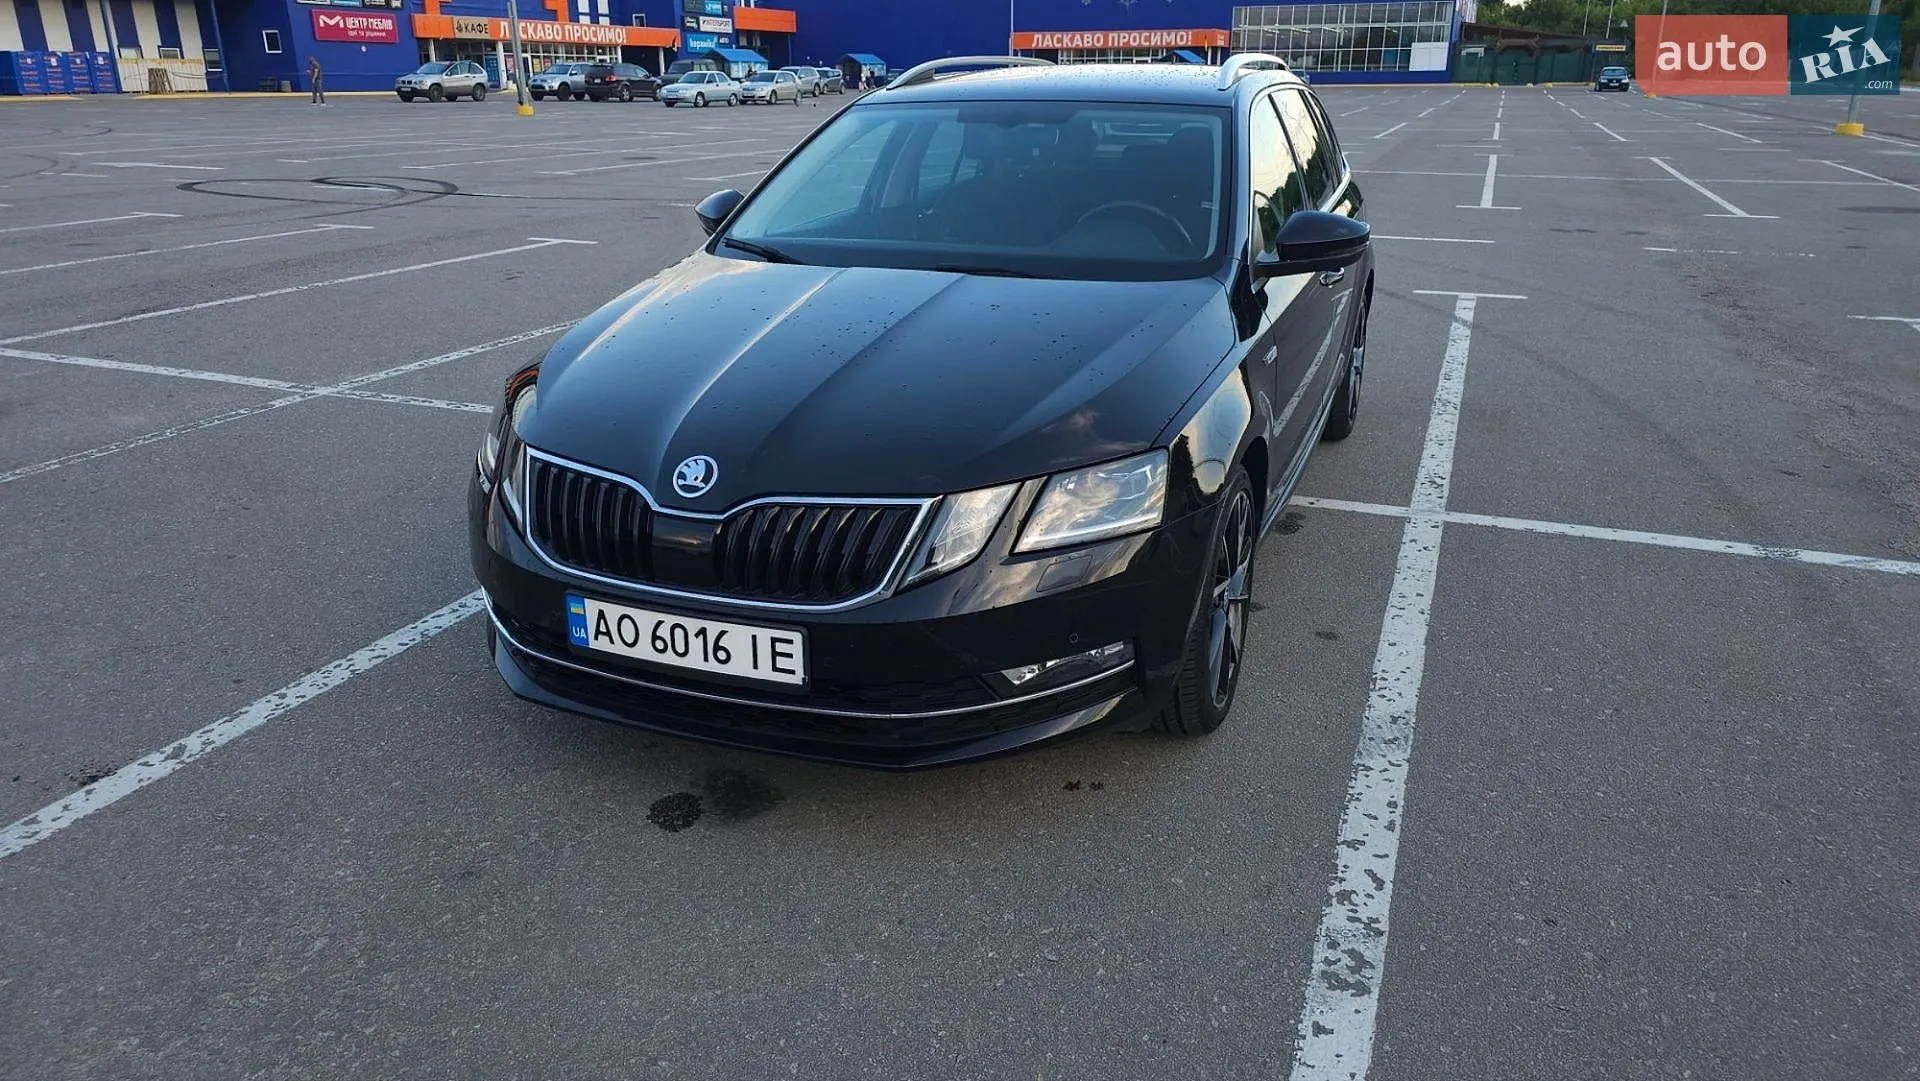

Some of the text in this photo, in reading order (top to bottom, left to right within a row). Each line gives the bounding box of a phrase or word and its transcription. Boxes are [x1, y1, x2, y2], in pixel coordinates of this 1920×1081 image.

[345, 17, 393, 30] ЦЕНТР МЕБЛІВ
[464, 22, 489, 34] КАФЕ
[500, 21, 627, 43] ЛСКАВО ПРОСИМО!
[1031, 31, 1193, 48] ЛАСКАВО ПРОСИМО!
[572, 626, 587, 640] UA
[593, 608, 640, 648] AO
[651, 619, 732, 665] 6016
